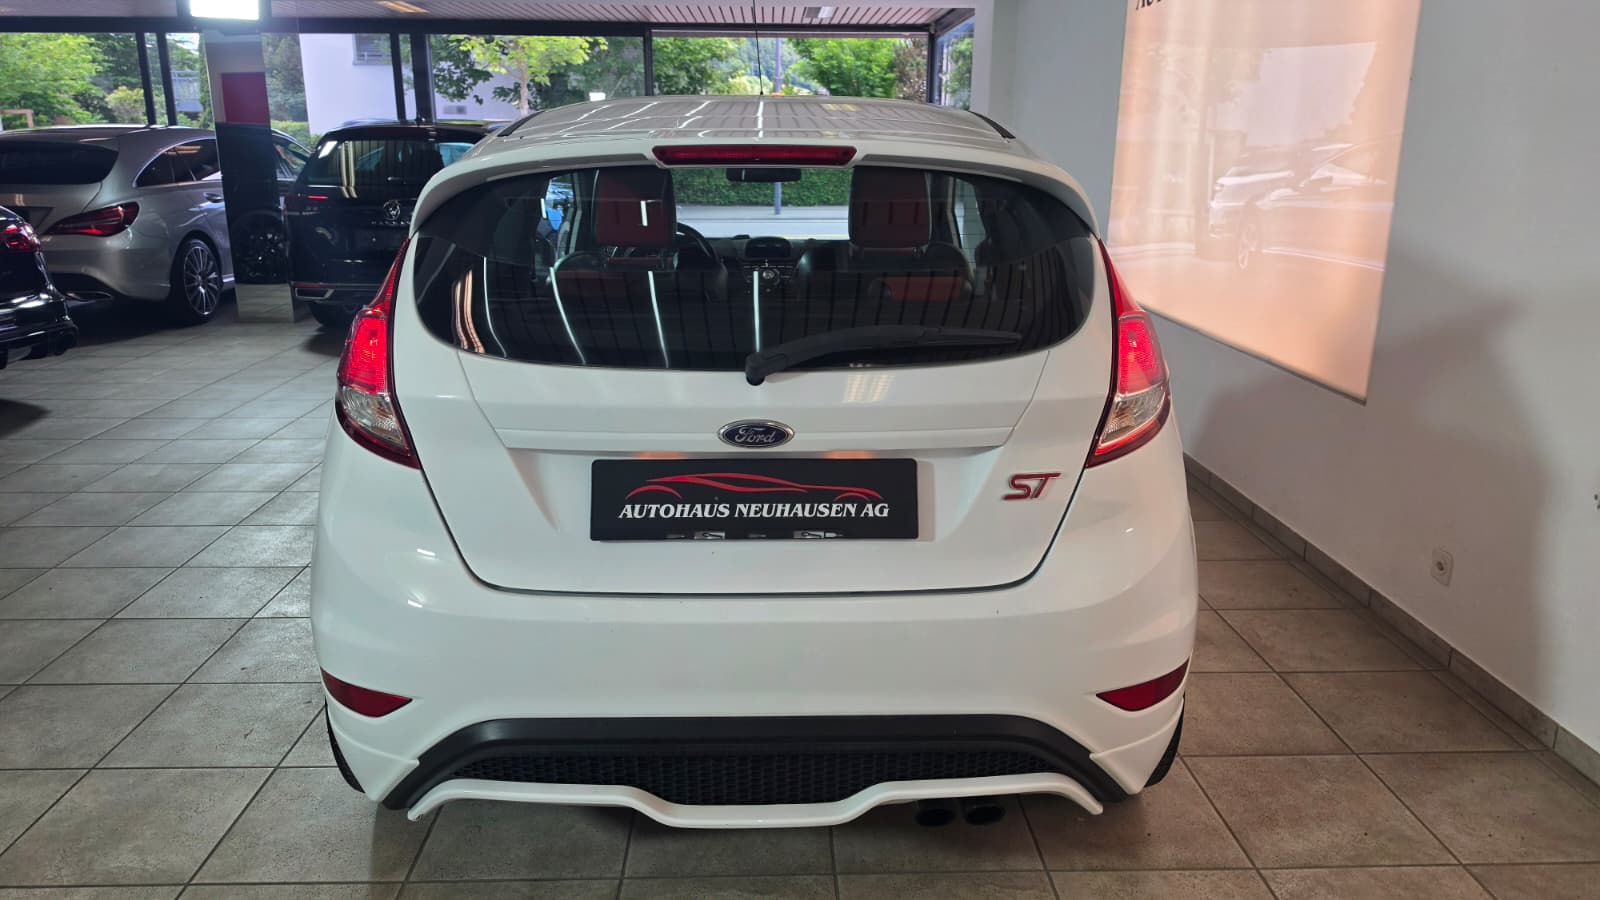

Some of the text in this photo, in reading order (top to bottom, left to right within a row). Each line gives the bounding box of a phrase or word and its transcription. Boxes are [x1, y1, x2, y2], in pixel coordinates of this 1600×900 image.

[734, 427, 777, 443] Ford
[1003, 472, 1061, 501] ST
[618, 503, 890, 519] AUTOHAUS NEUHAUSEN AG
